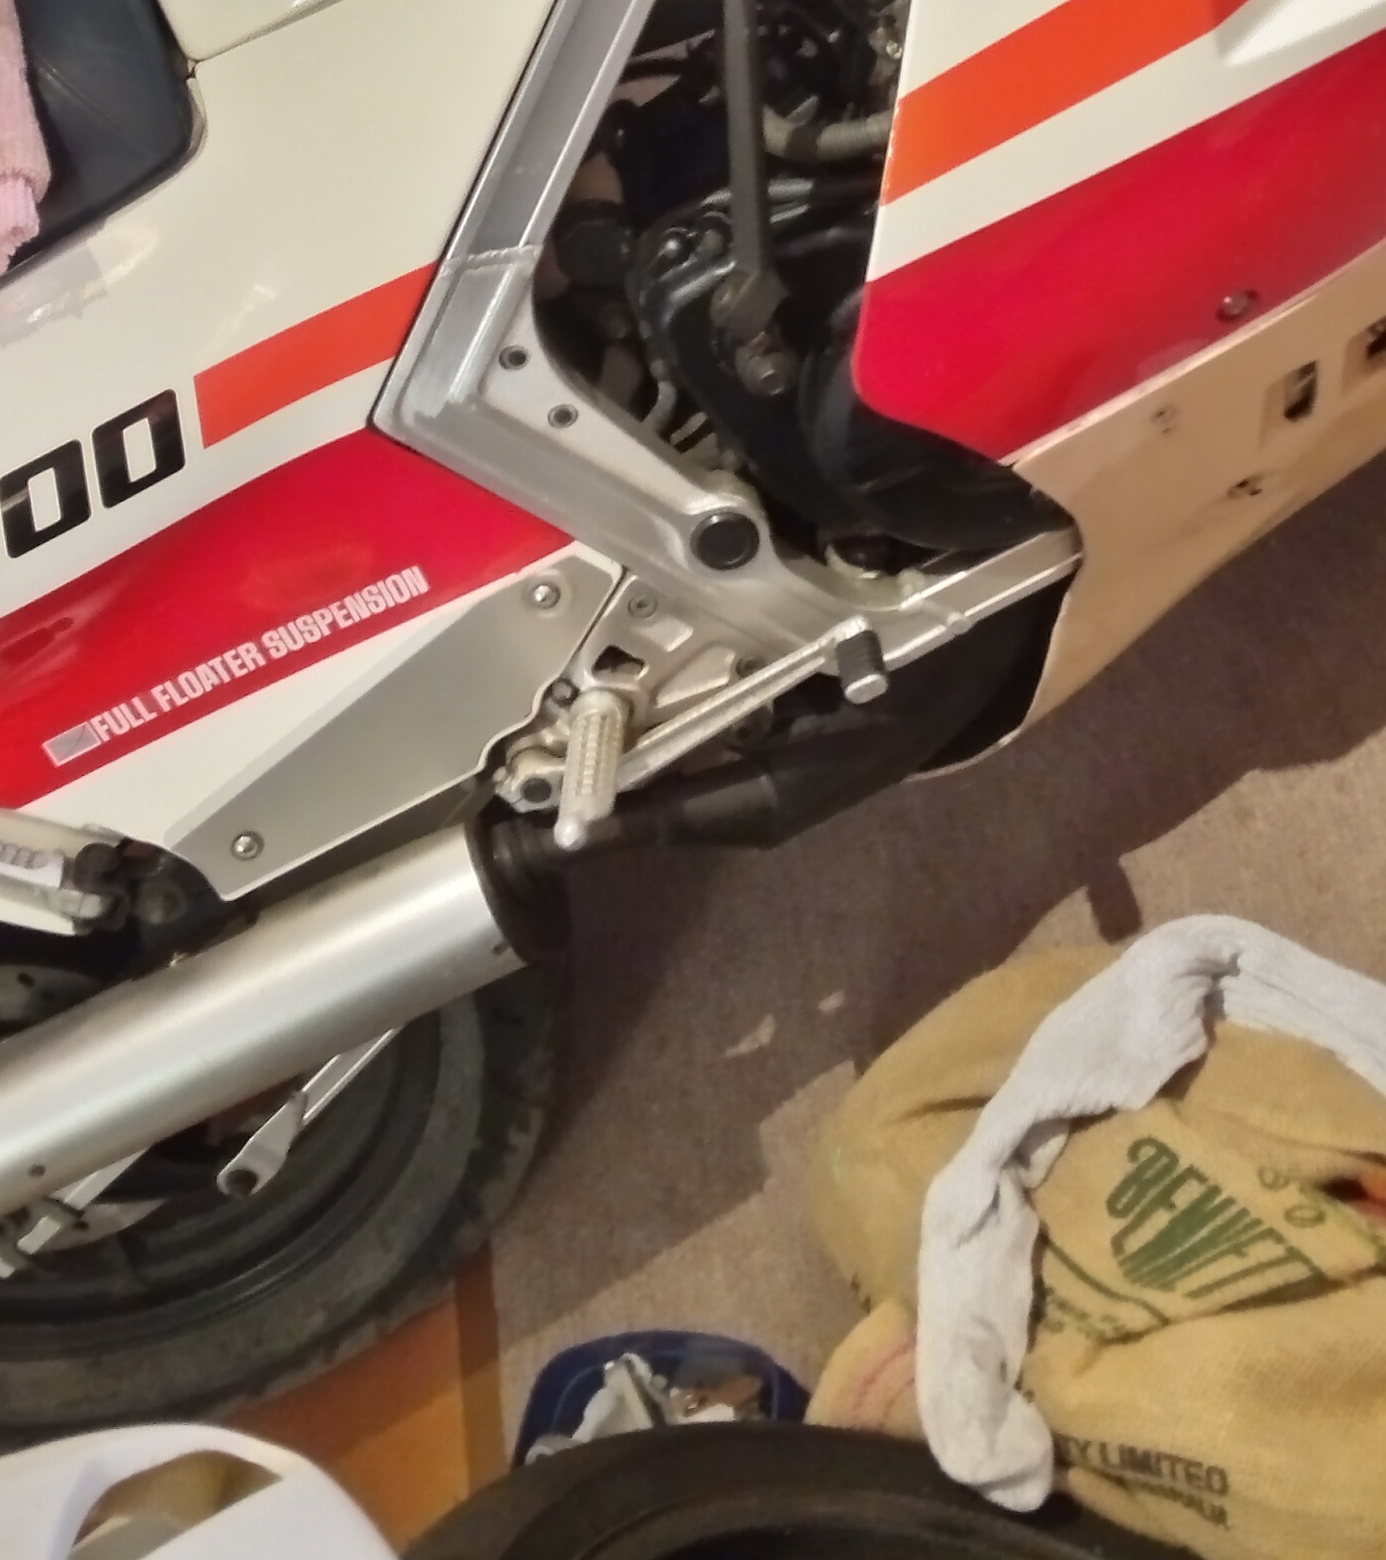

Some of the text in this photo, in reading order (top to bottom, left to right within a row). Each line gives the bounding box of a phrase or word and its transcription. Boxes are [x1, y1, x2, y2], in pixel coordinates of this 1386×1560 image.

[89, 564, 431, 742] FULL FLOATER SUSPENSION
[1098, 1440, 1230, 1497] LIMITED
